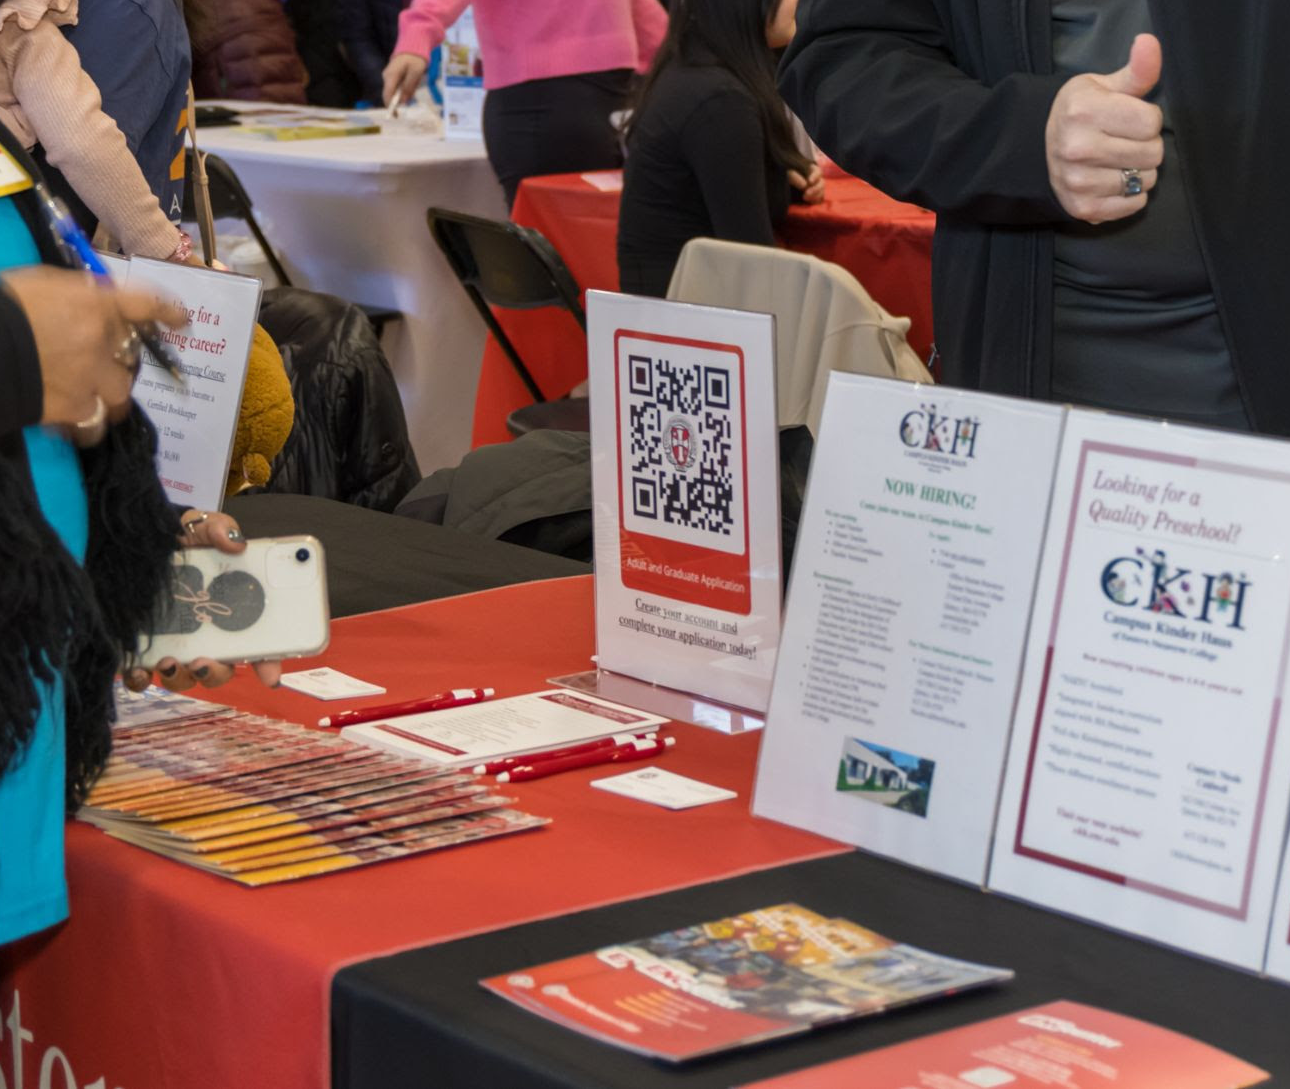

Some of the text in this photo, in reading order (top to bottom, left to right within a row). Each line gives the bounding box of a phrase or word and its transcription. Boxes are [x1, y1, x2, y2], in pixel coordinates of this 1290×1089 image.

[197, 306, 213, 323] for
[213, 313, 221, 326] a
[189, 336, 227, 355] career?
[899, 409, 981, 459] CKH
[884, 477, 977, 511] NOW HIRING!
[1092, 469, 1201, 507] Looking for a
[1088, 498, 1243, 545] Quality Preschool?
[626, 557, 746, 593] Adult and Graduate Application
[1100, 552, 1253, 631] CKH
[635, 597, 738, 634] Create your account and
[1102, 610, 1234, 649] Campus Kinder Haus
[618, 615, 757, 661] complete your application today!
